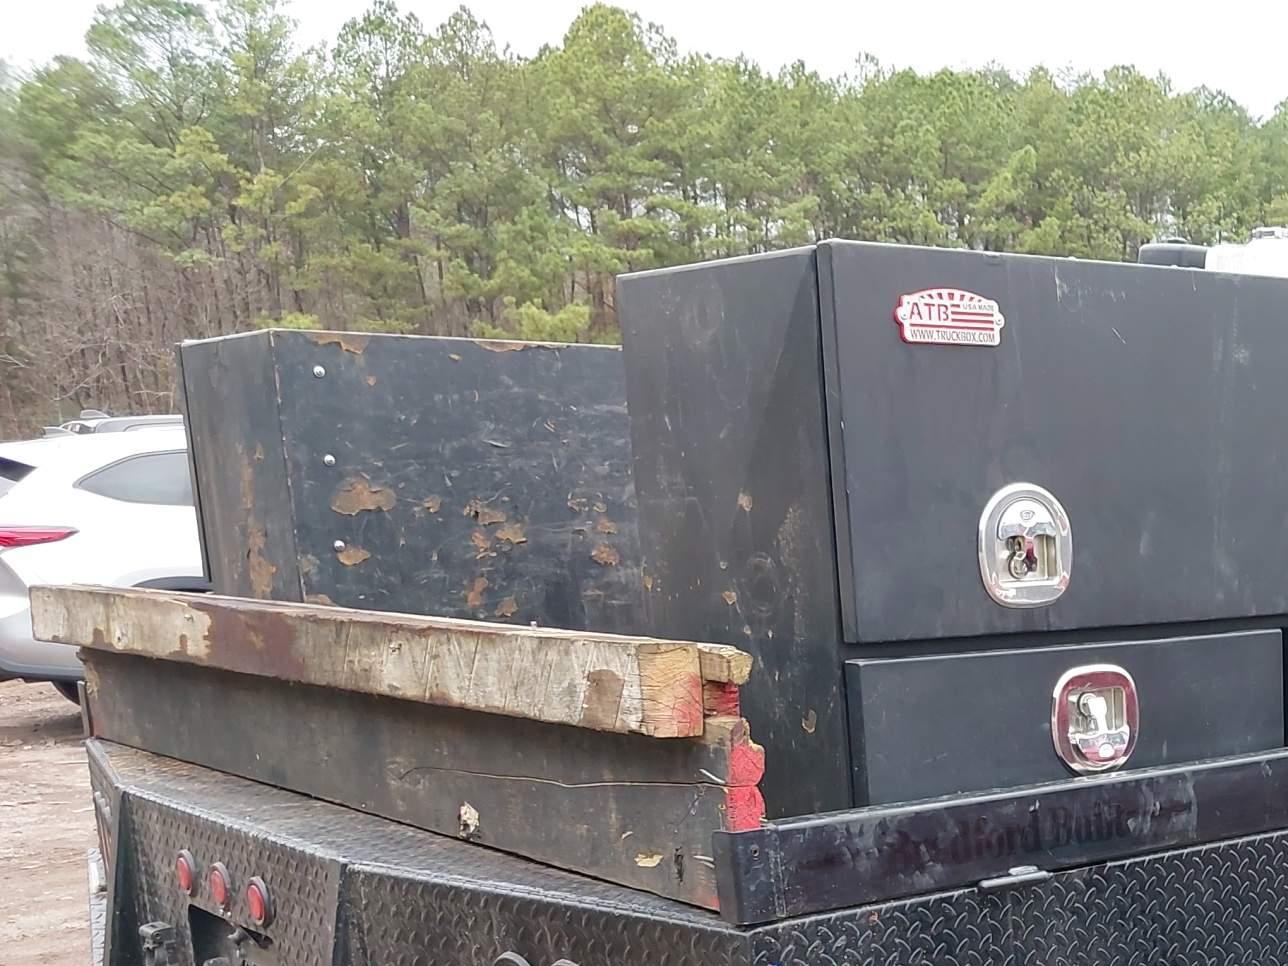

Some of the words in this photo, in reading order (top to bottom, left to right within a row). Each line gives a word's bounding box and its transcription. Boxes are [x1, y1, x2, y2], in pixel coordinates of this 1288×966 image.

[909, 302, 949, 321] ATB
[962, 303, 977, 311] USA
[910, 329, 996, 343] WWW.TRUCKBOX.COM
